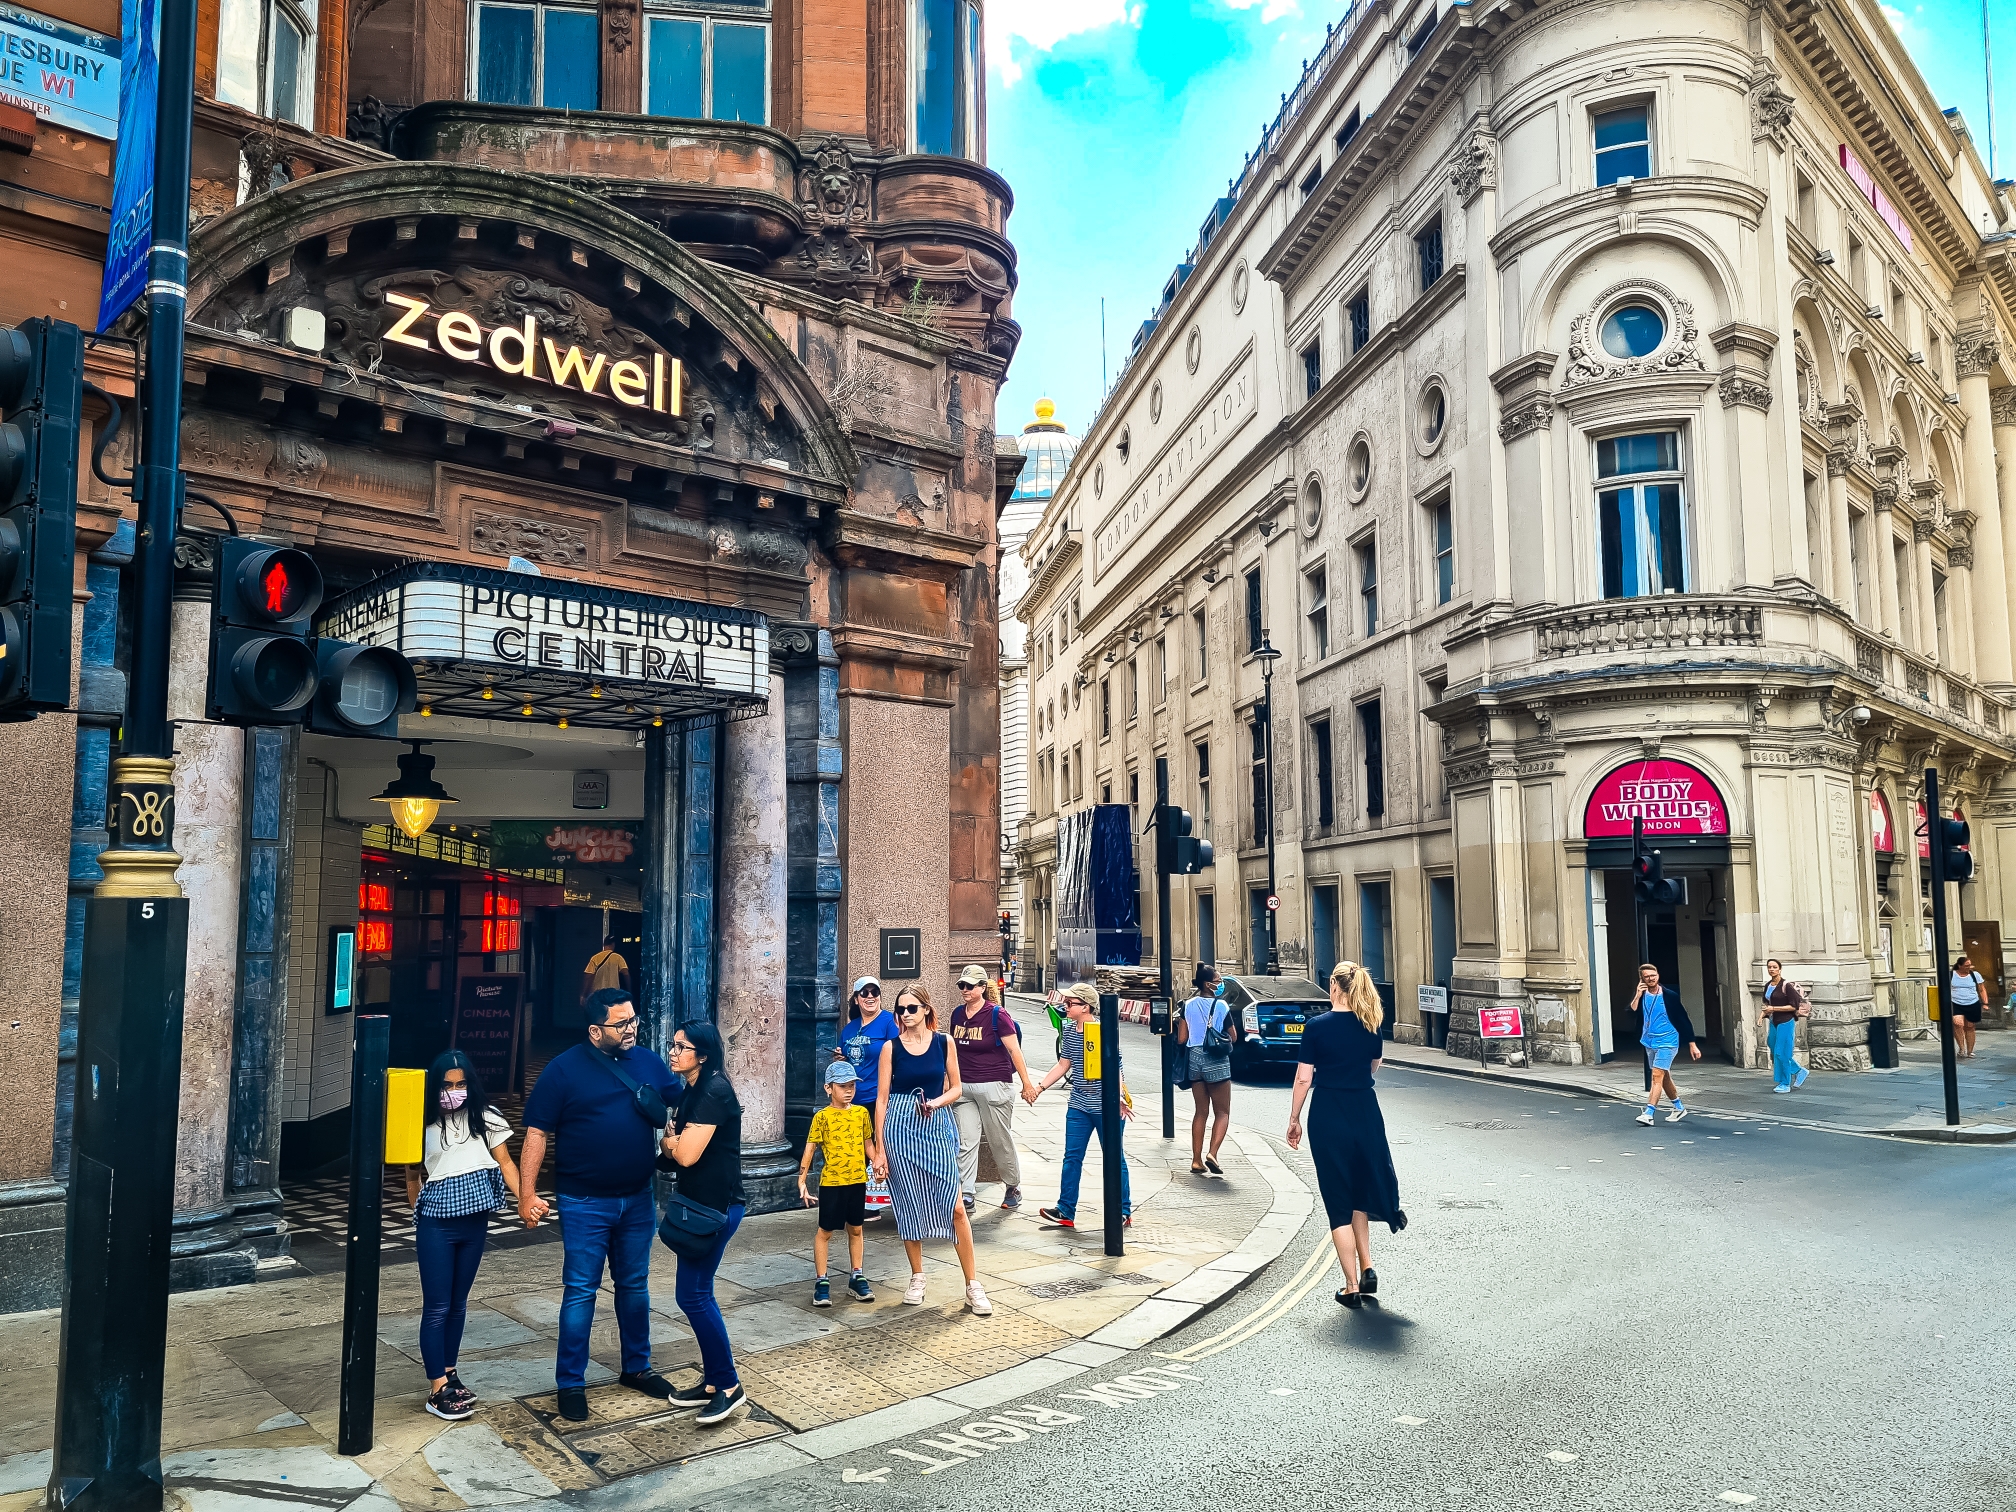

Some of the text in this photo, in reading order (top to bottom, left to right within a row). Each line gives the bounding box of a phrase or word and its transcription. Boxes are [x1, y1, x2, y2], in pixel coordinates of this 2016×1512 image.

[41, 69, 75, 99] W1
[108, 184, 154, 270] FROZE
[382, 292, 682, 417] zedwell
[1100, 375, 1247, 561] LONDON PAVILION
[472, 587, 756, 652] PICTUREHOUSE
[492, 626, 716, 685] CENTRAL
[1620, 783, 1693, 802] BODY
[1602, 801, 1711, 821] WORLDS
[1632, 821, 1681, 830] NDON
[141, 902, 155, 919] 5
[1268, 899, 1279, 907] 20
[463, 1009, 511, 1018] CINEMA
[490, 1030, 510, 1039] BAR
[887, 1364, 1206, 1475] LOOK RIGHT
